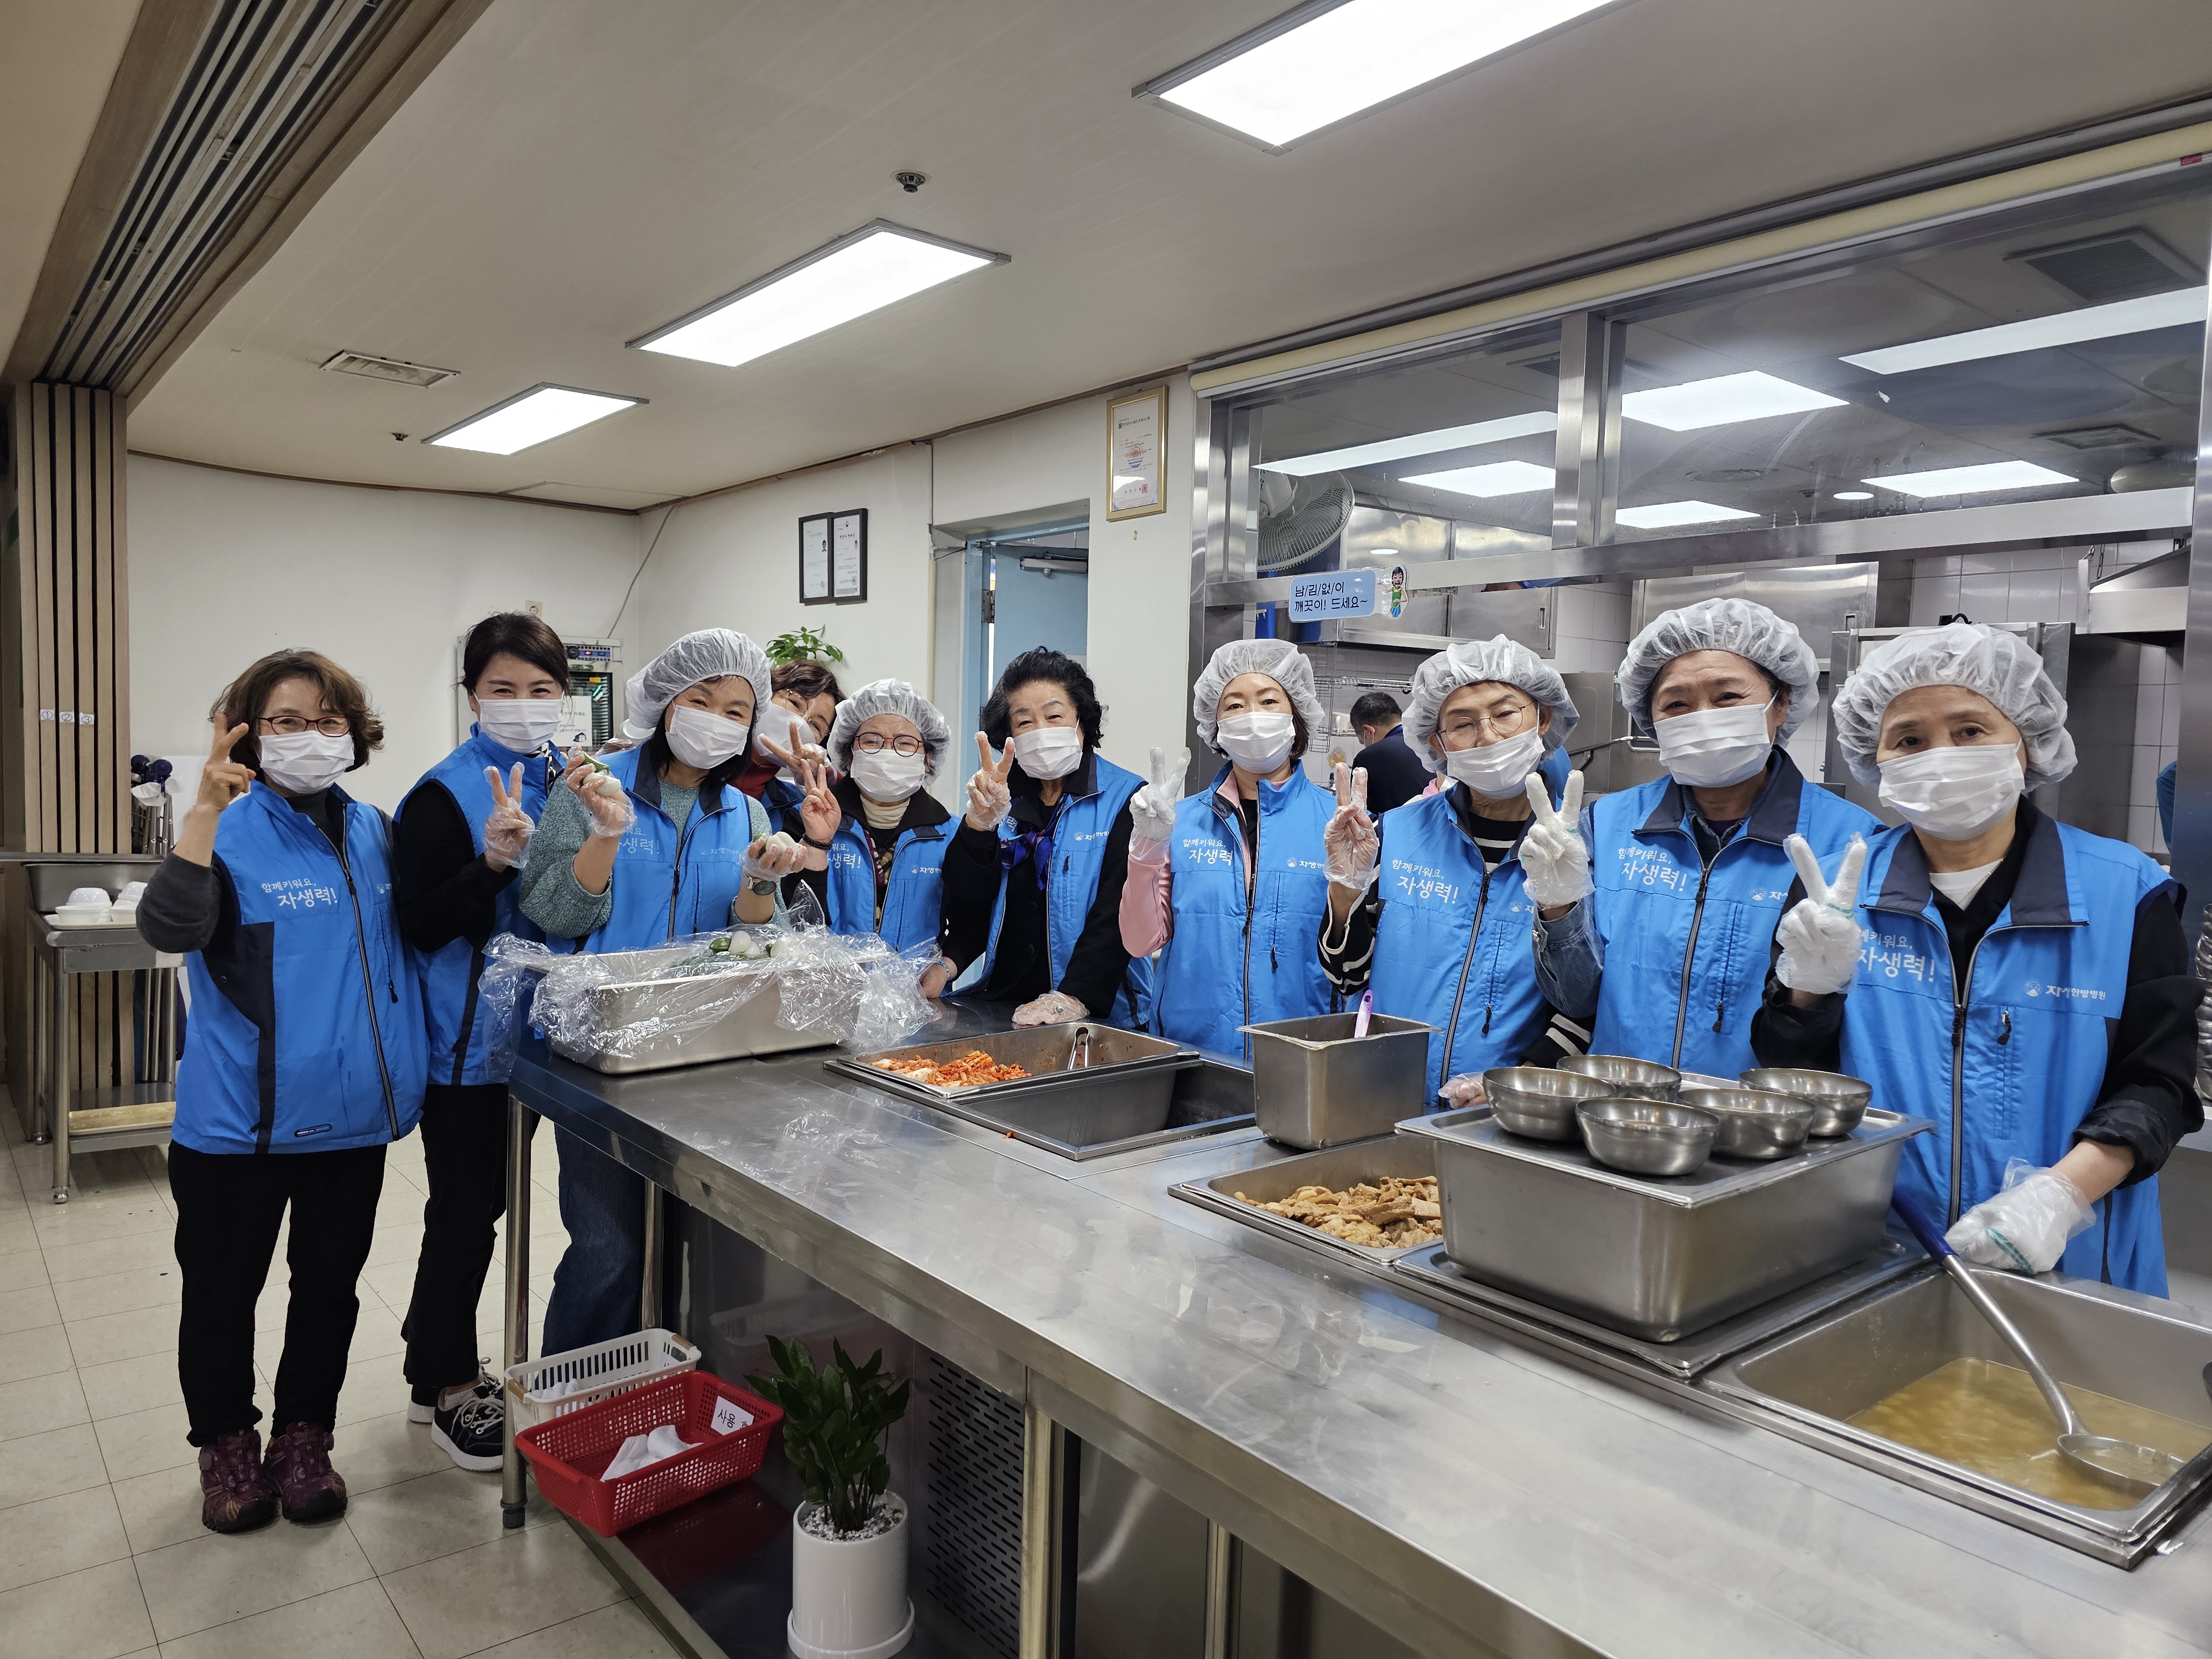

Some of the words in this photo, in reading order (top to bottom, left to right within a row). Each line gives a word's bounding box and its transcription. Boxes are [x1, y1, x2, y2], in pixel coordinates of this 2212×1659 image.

[1295, 581, 1344, 597] 남/김/없/이
[1295, 599, 1326, 612] 깨끗이!
[1331, 596, 1368, 609] 드세요~
[617, 837, 660, 855] 생력!
[830, 843, 849, 852] 워요,
[1183, 838, 1227, 848] 함께키워요,
[827, 853, 861, 869] 생력!
[1392, 859, 1444, 880] 함께키워요,
[1621, 860, 1687, 892] 자생력!
[260, 878, 316, 894] 함께키워요,
[1397, 876, 1459, 904] 자생력!
[277, 886, 338, 910] 자생력!
[1858, 947, 1935, 983] 자생력!
[717, 1408, 735, 1428] 사용
